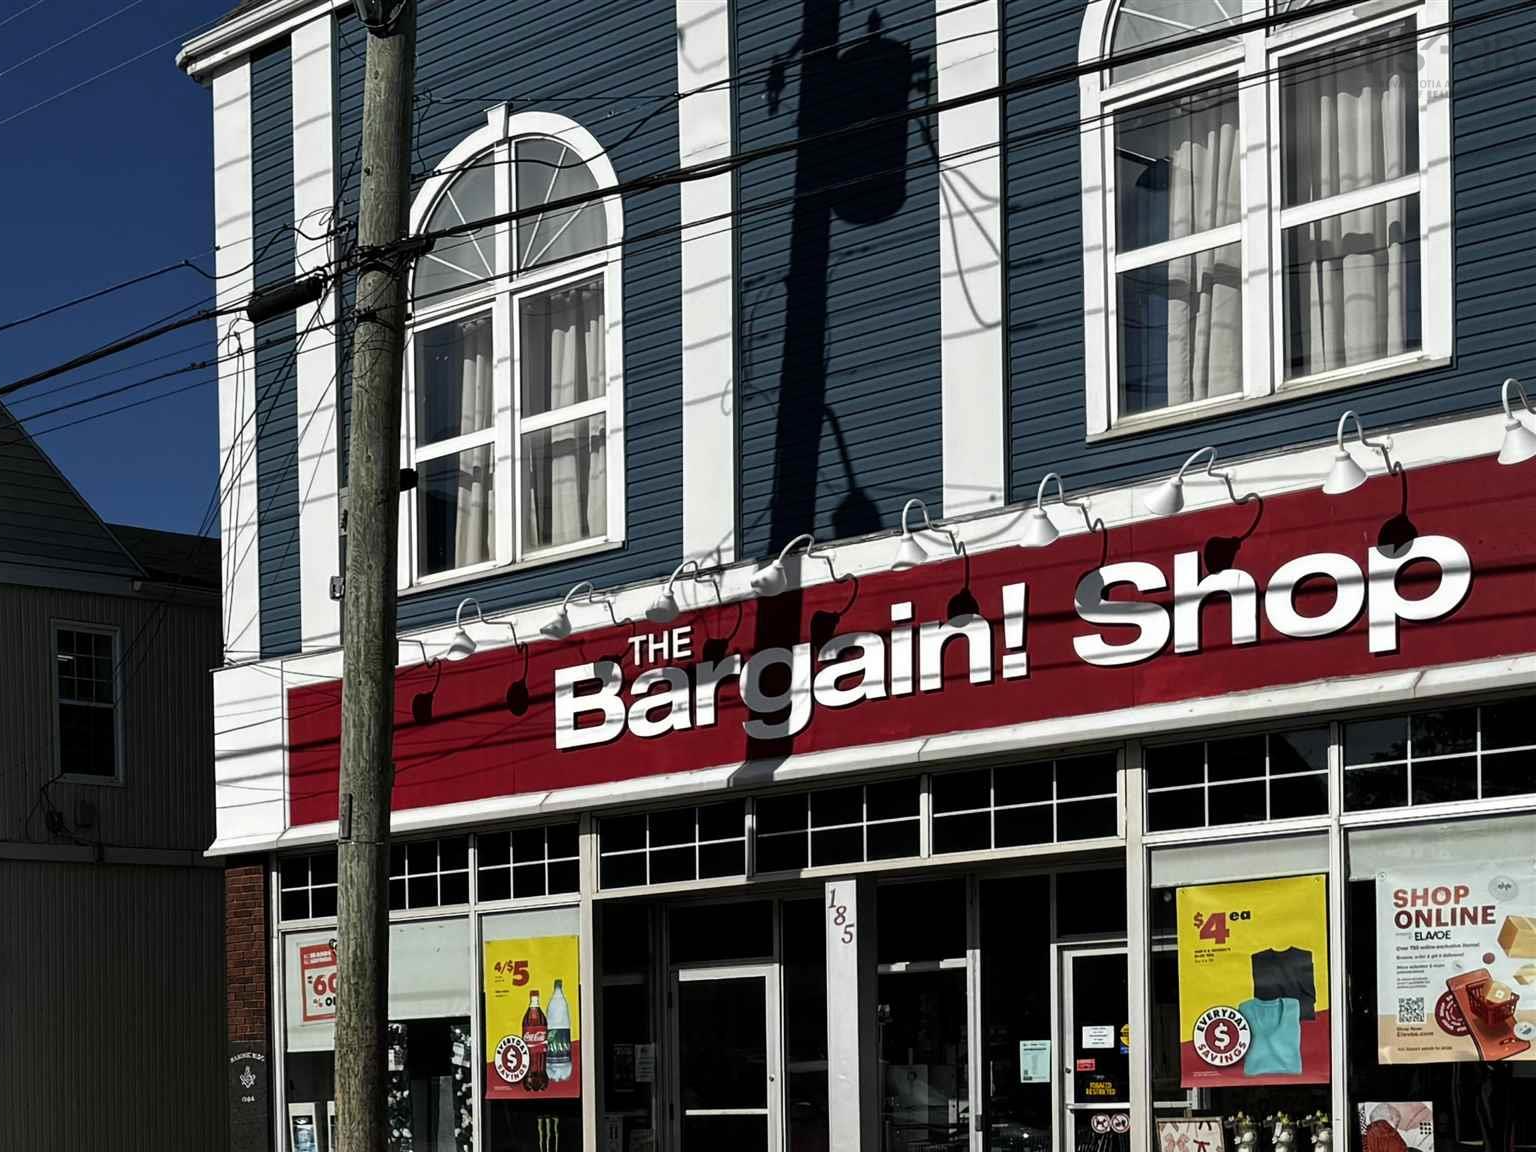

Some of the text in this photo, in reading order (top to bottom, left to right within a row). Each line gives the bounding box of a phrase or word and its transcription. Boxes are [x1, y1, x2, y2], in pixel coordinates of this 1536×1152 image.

[555, 534, 1472, 749] Bargain! Shop
[628, 626, 692, 665] THE
[1393, 885, 1470, 908] SHOP
[828, 887, 855, 944] 185
[1394, 905, 1497, 929] ONLINE
[1197, 1008, 1248, 1032] EVERYDAY
[497, 1037, 528, 1055] EVERYDAY
[1198, 1041, 1247, 1063] SAVINGS
[497, 1063, 528, 1080] SAVINGS
